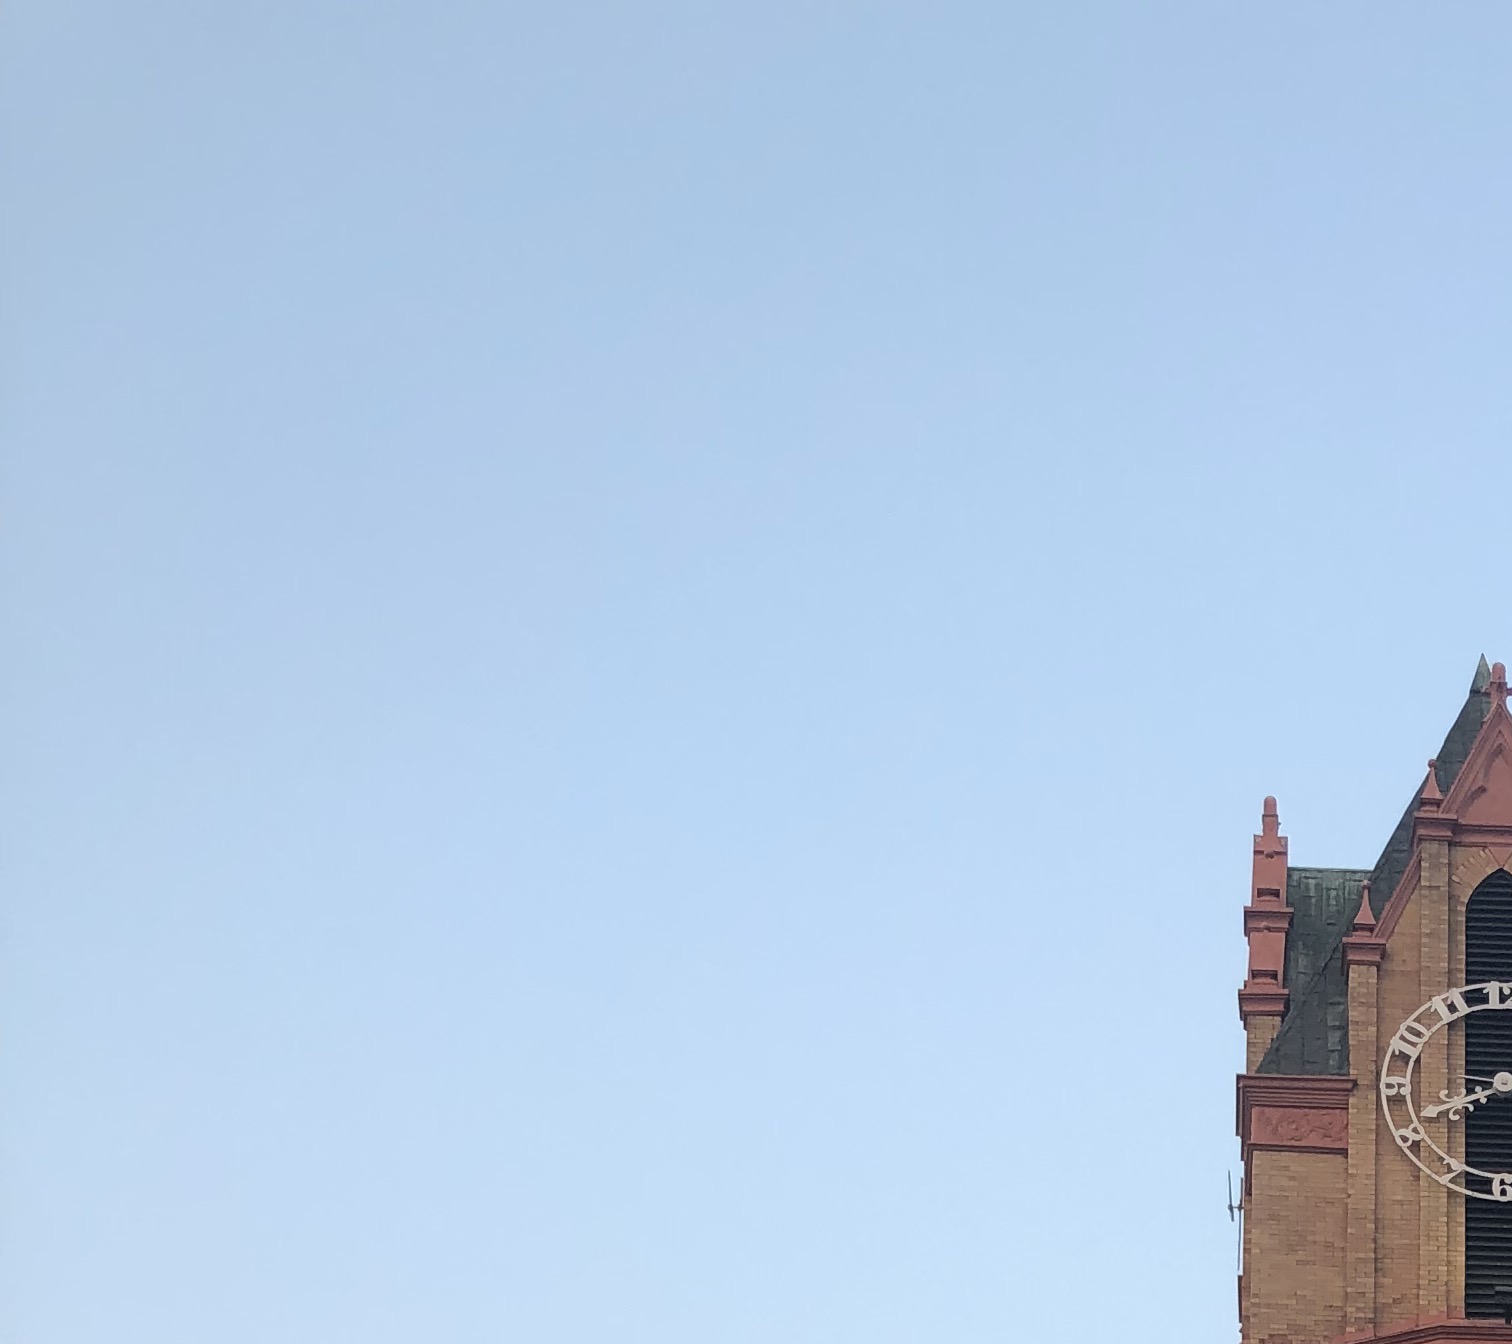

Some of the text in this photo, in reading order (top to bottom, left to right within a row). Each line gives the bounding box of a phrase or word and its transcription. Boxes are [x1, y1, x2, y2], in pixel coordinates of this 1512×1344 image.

[1430, 988, 1470, 1024] 11
[1390, 1021, 1430, 1057] 10
[1380, 1076, 1411, 1096] 9
[1396, 1122, 1425, 1148] 8
[1440, 1158, 1465, 1185] 7
